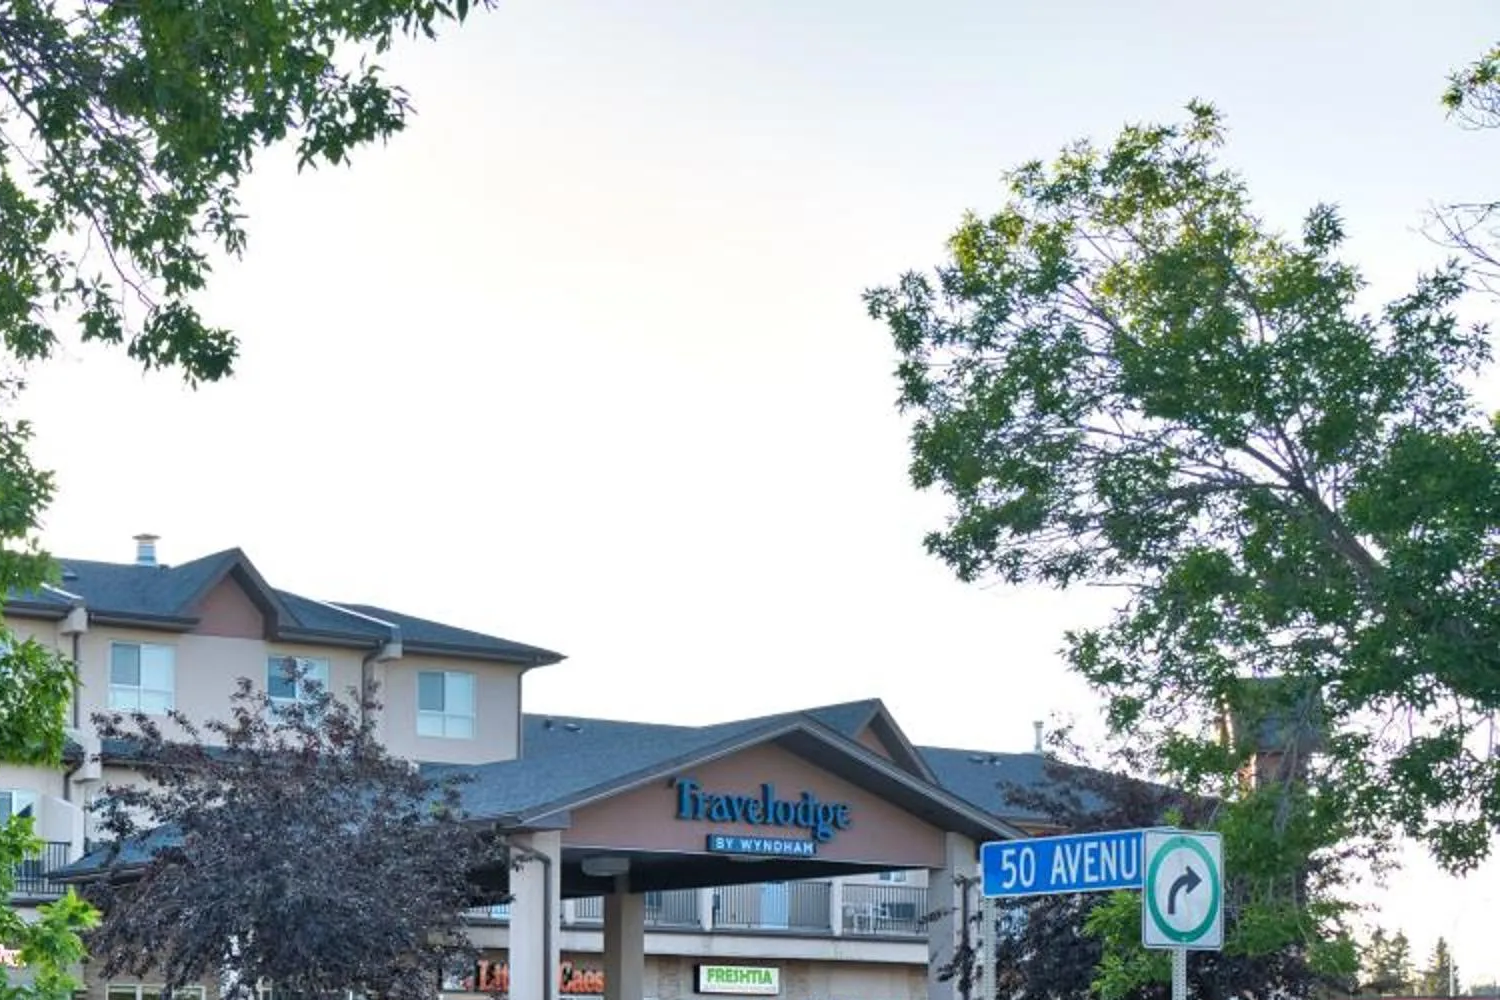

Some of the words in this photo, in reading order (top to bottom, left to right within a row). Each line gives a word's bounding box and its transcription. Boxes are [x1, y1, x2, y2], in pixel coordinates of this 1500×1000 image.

[676, 777, 853, 842] Travelodge
[715, 836, 734, 850] BY
[741, 838, 815, 854] WYNDHAM
[1001, 846, 1036, 890] 50
[1050, 837, 1138, 886] AVENU
[559, 960, 606, 993] Caes
